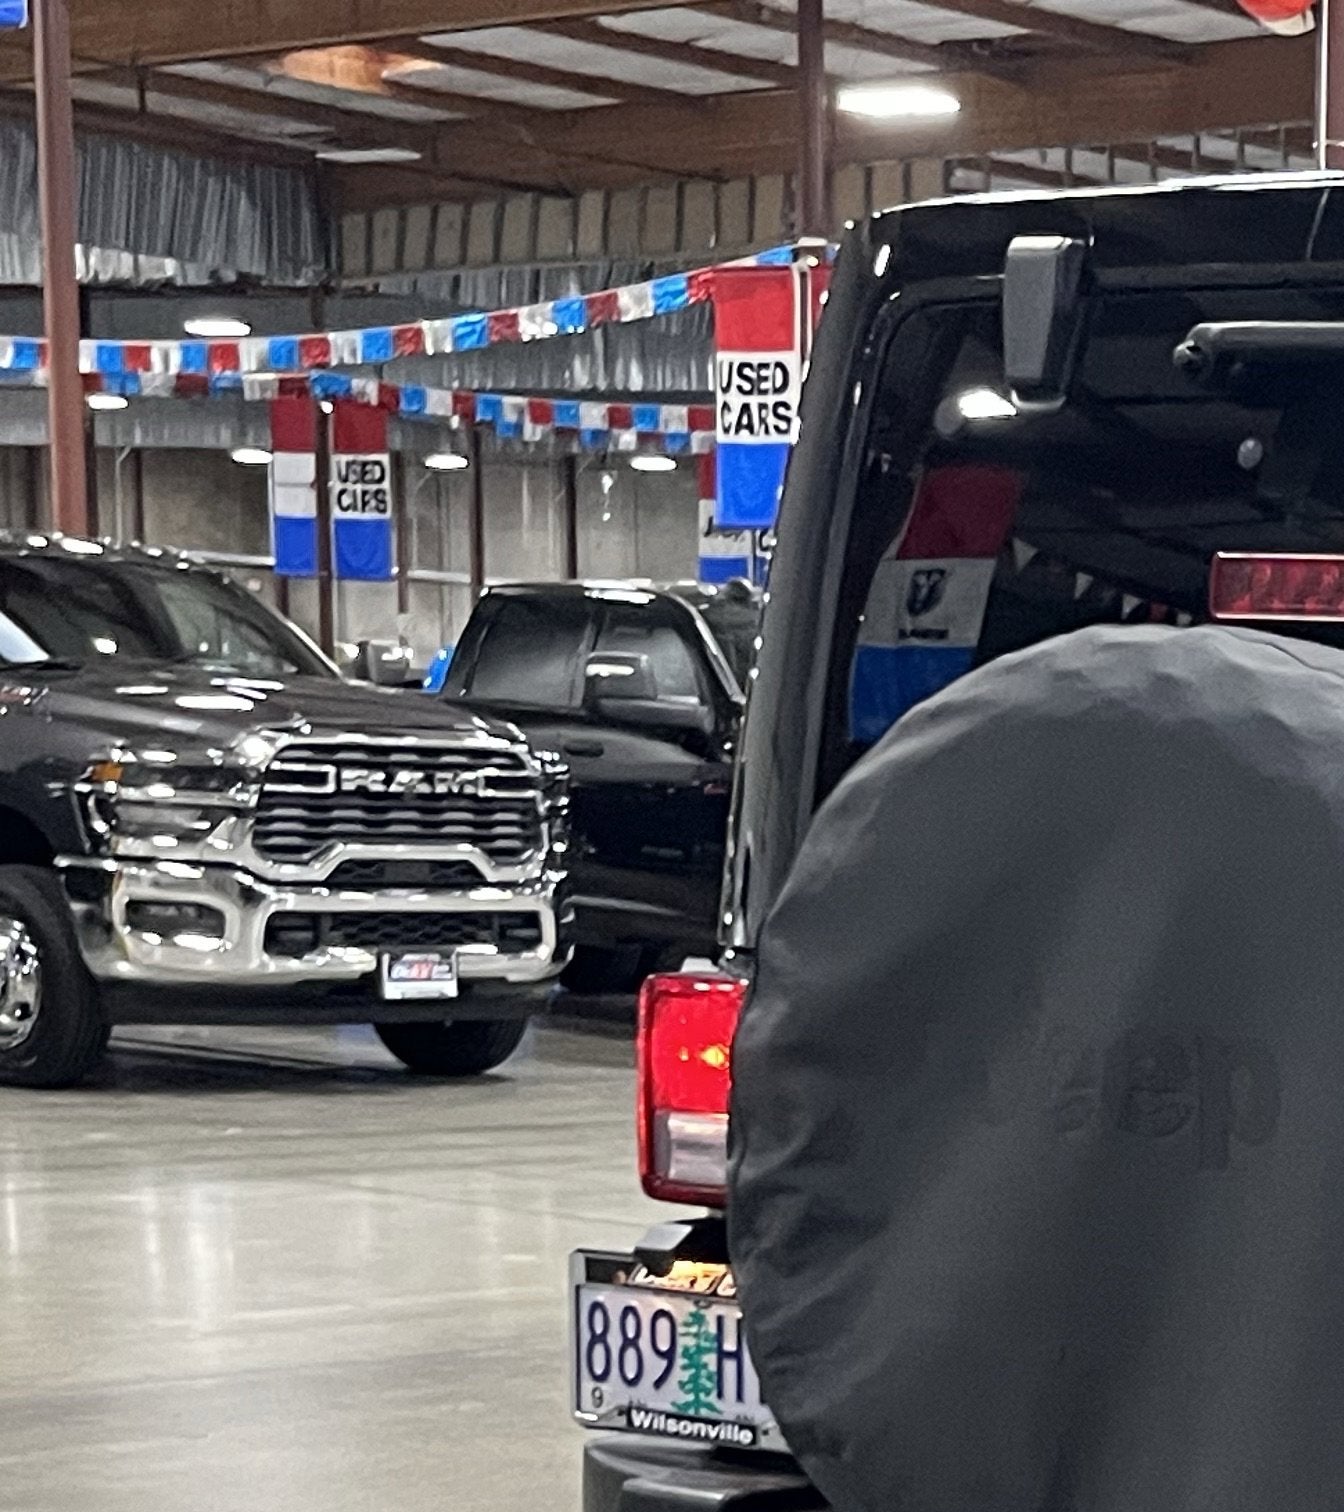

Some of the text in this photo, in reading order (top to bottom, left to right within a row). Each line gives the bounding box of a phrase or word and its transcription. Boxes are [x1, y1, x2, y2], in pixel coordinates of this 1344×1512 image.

[719, 361, 790, 396] USED
[720, 400, 792, 436] CARS
[585, 1300, 678, 1391] 889
[630, 1408, 754, 1445] Wilsonville
